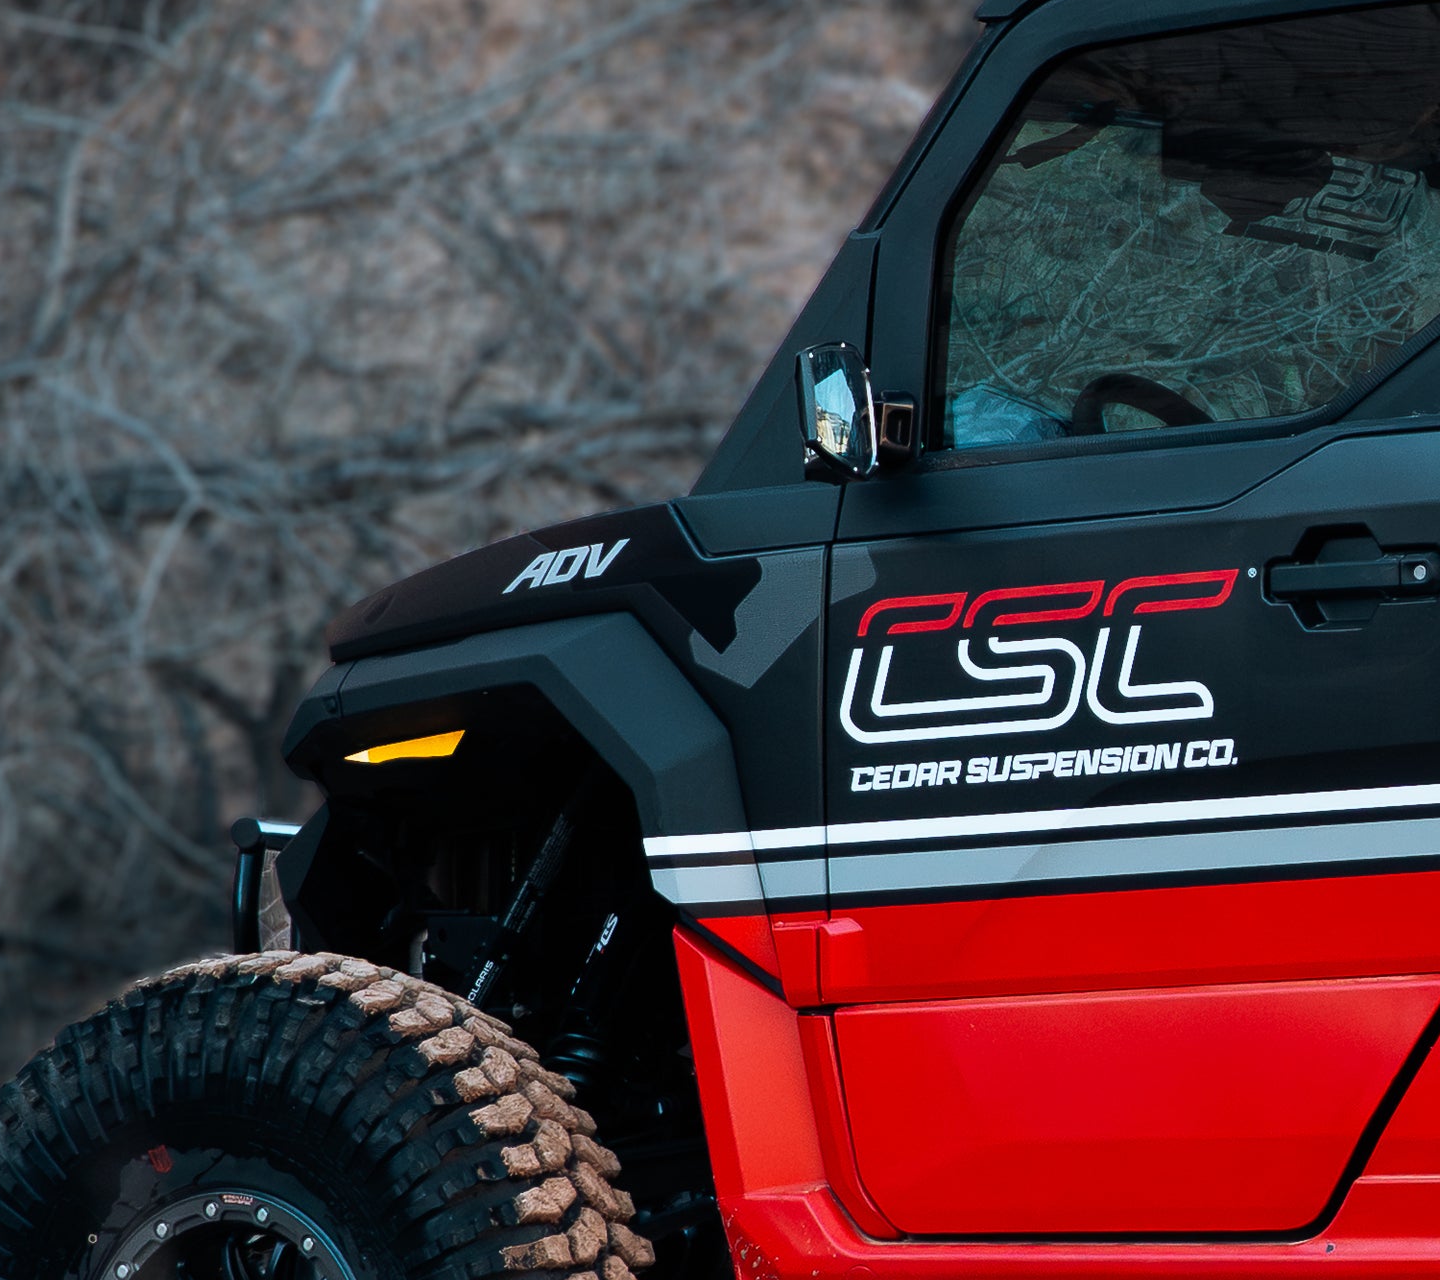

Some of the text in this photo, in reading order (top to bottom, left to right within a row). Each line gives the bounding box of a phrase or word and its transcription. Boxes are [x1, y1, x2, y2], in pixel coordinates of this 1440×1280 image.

[502, 538, 630, 594] ADV
[850, 738, 1239, 792] CEDAR SUSPENSION CO.
[466, 960, 495, 1002] OLARIS
